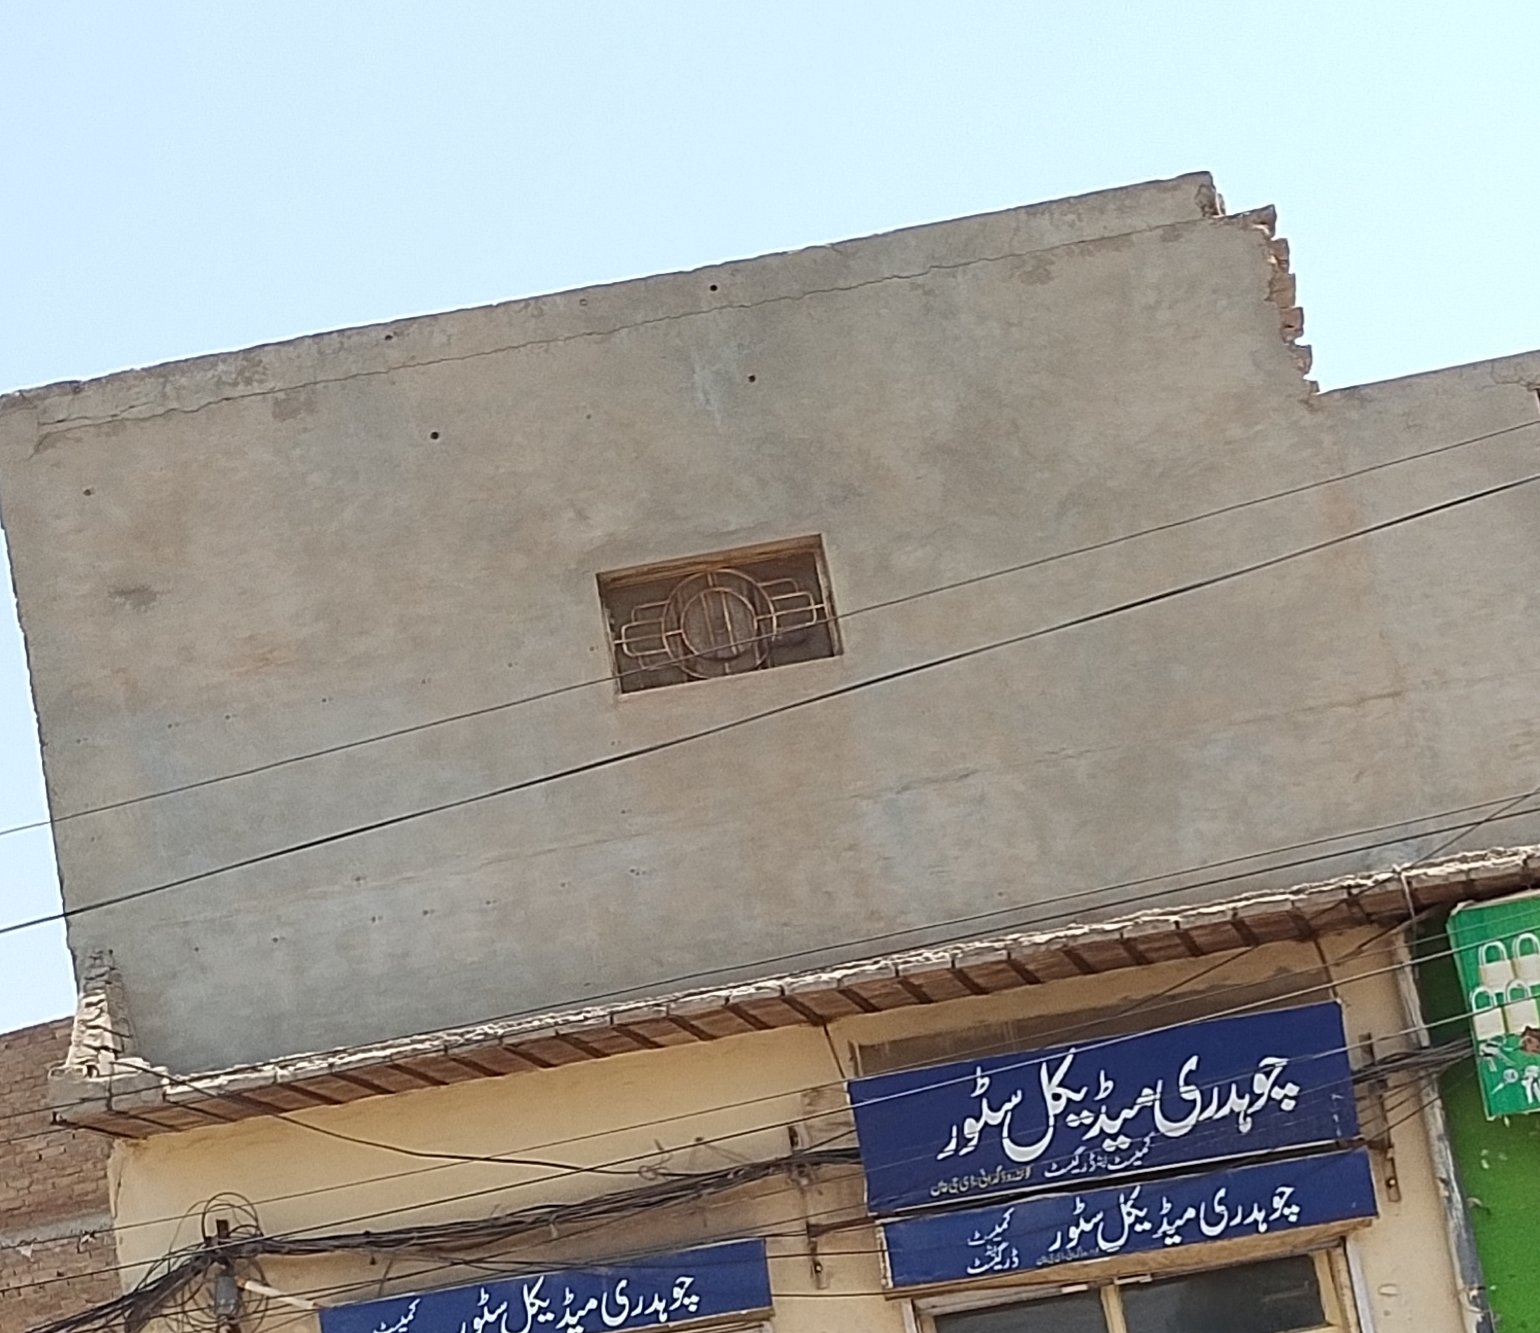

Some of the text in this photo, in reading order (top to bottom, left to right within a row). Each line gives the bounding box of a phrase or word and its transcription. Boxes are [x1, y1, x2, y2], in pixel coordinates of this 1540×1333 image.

[936, 1047, 1300, 1162] چوہدری میڈیکل سٹور
[1048, 1184, 1301, 1252] چوہدری میڈیکل سٹور
[601, 1273, 700, 1327] چوہدری
